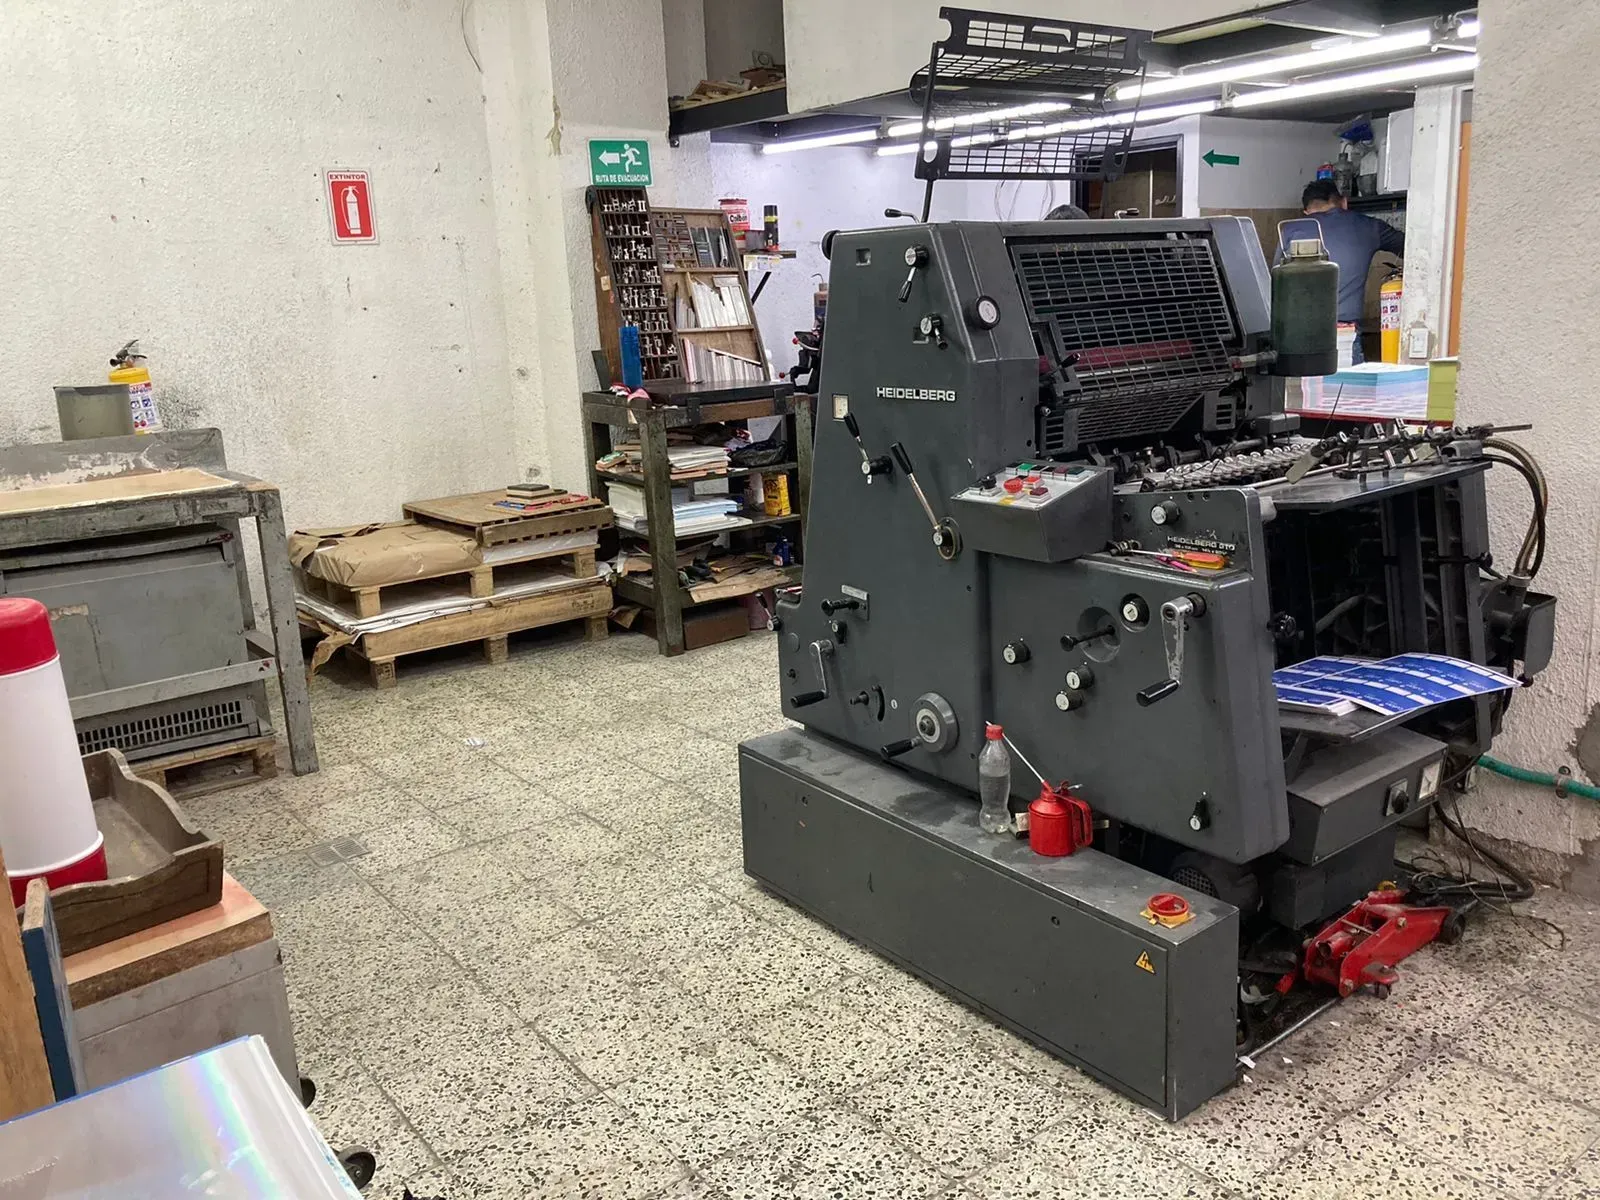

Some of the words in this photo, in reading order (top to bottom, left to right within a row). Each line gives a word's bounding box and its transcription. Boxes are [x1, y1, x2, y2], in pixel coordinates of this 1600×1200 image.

[595, 174, 609, 183] RUTA
[610, 174, 617, 183] DE
[876, 386, 956, 402] HEIDELBERG
[1167, 536, 1217, 549] HEIDELBERG
[1218, 542, 1236, 551] GTO
